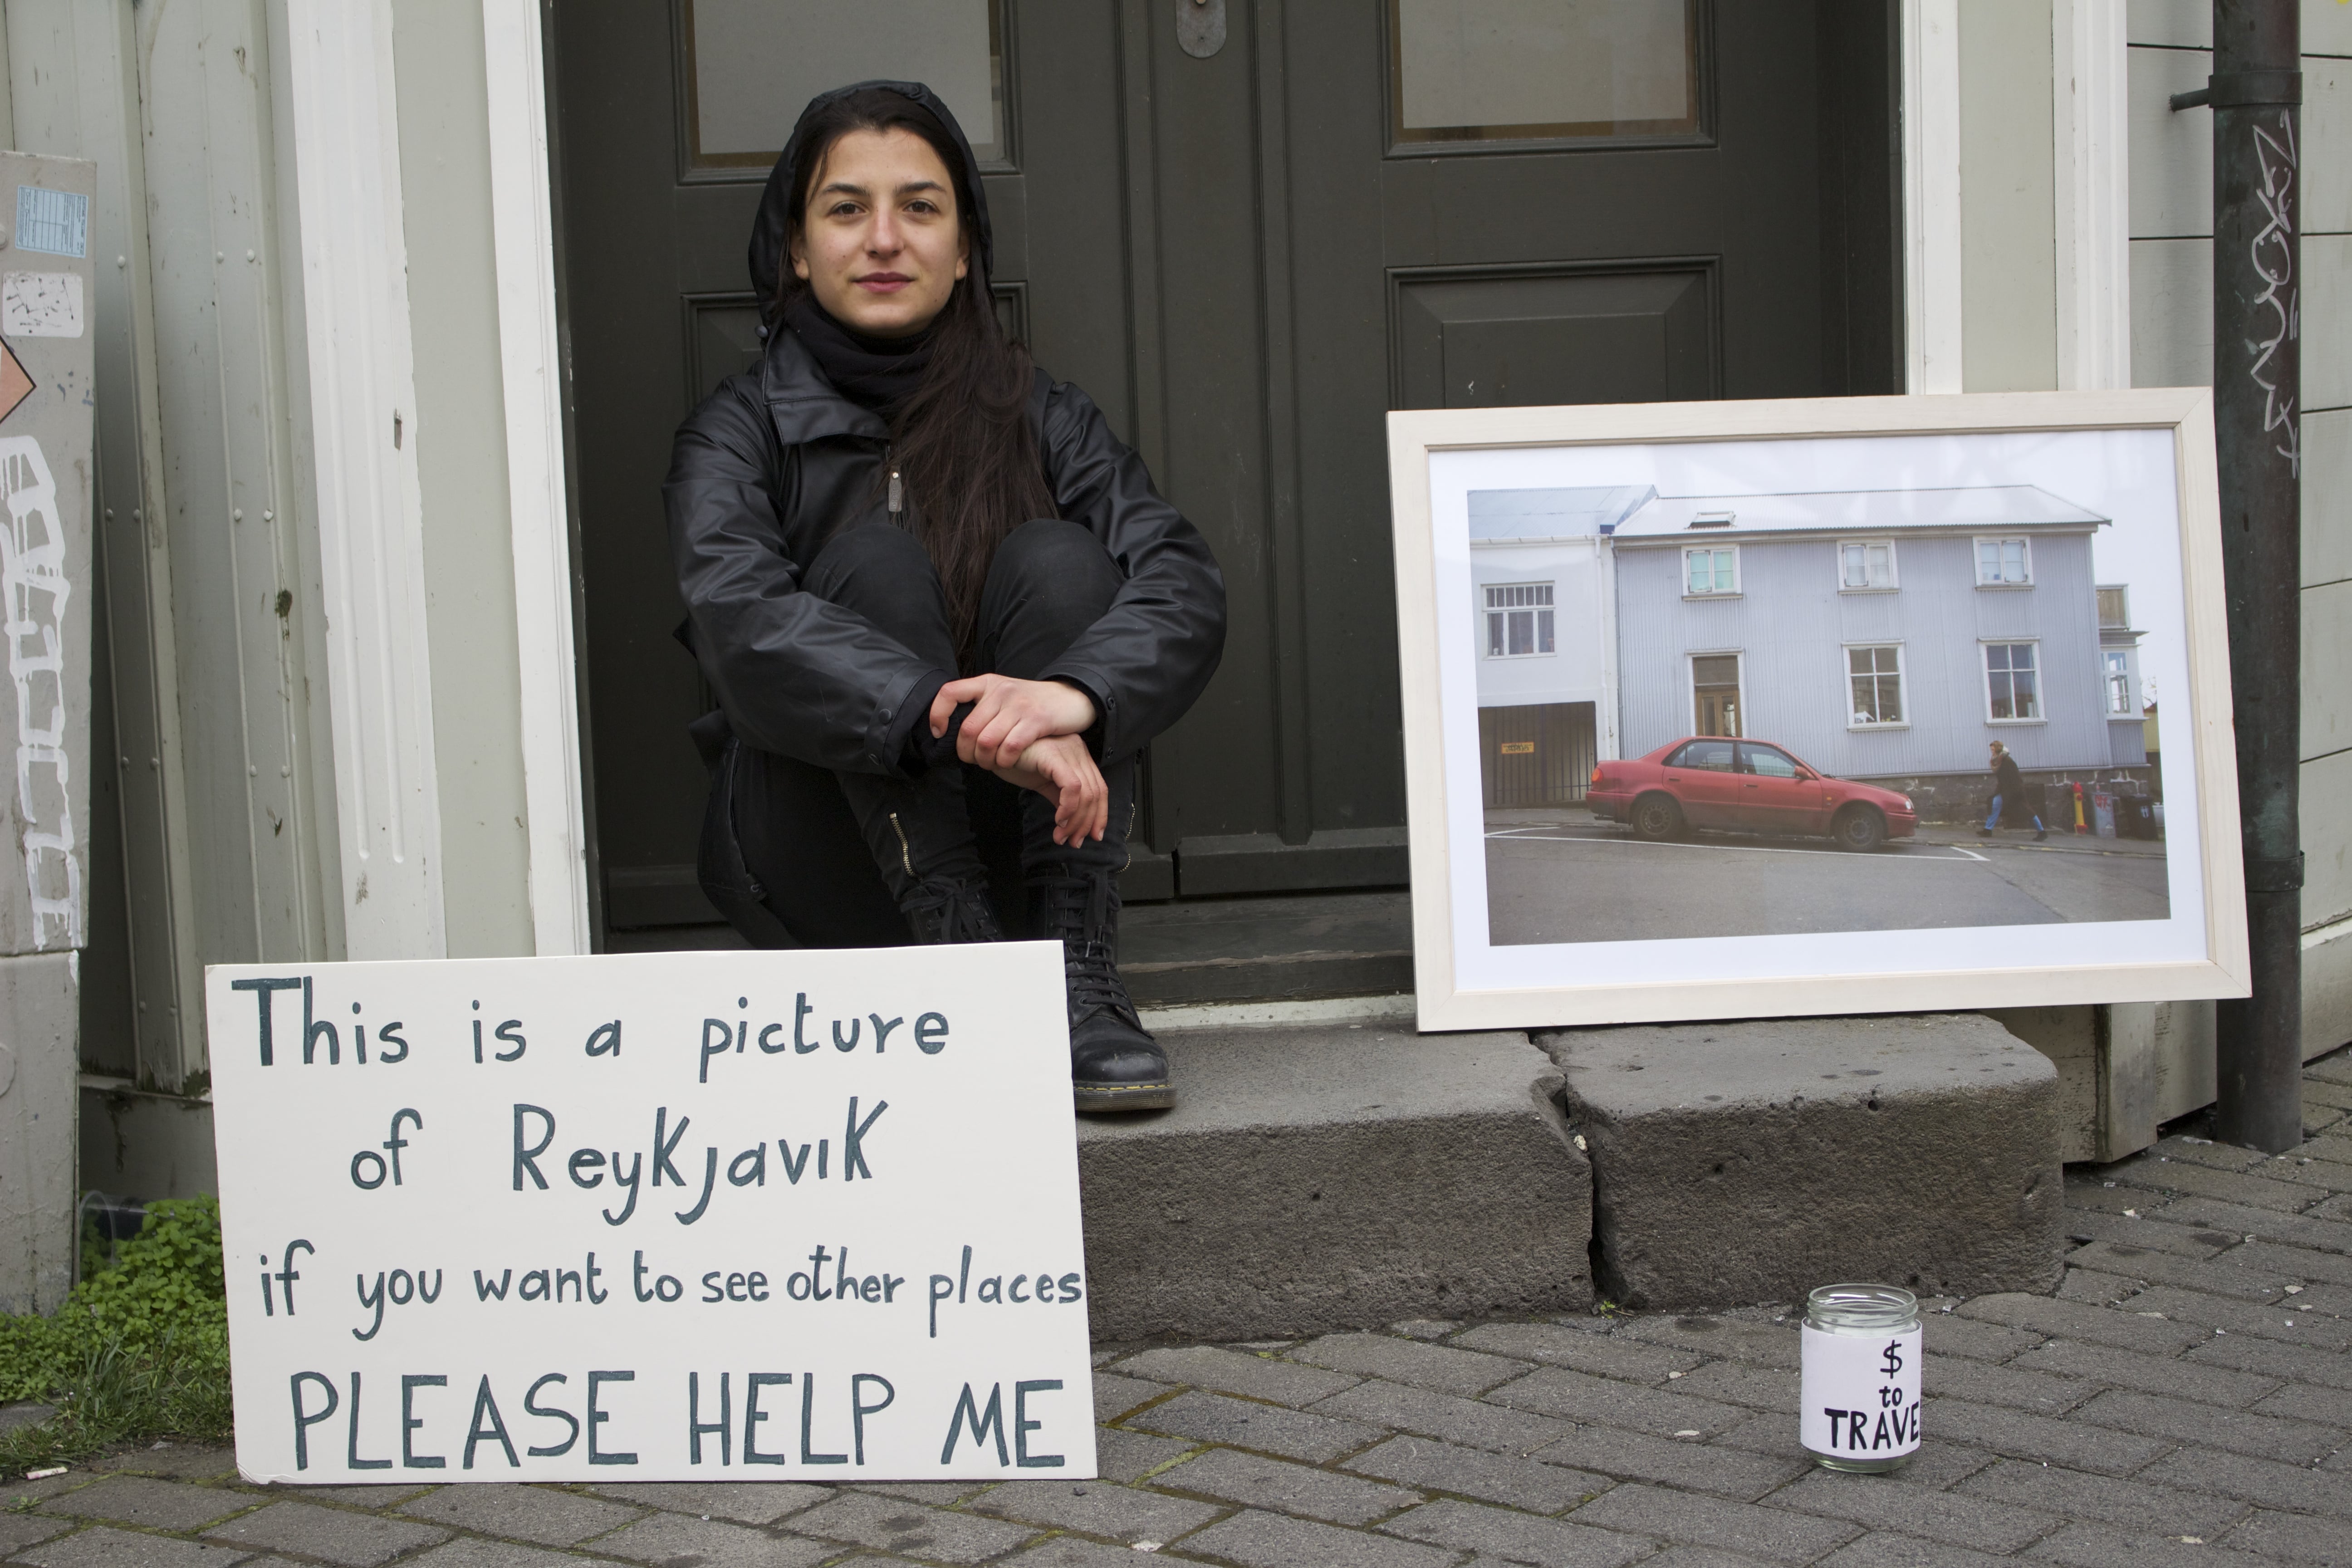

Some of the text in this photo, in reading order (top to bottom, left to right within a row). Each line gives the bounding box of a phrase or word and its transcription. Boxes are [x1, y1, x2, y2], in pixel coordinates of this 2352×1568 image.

[231, 975, 949, 1083] This is a picture
[351, 1108, 423, 1190] of
[260, 1239, 1082, 1342] if you want to see other places
[1879, 1386, 1903, 1408] to
[1880, 1339, 1903, 1379] $
[290, 1370, 1065, 1471] PLEASE HELP ME
